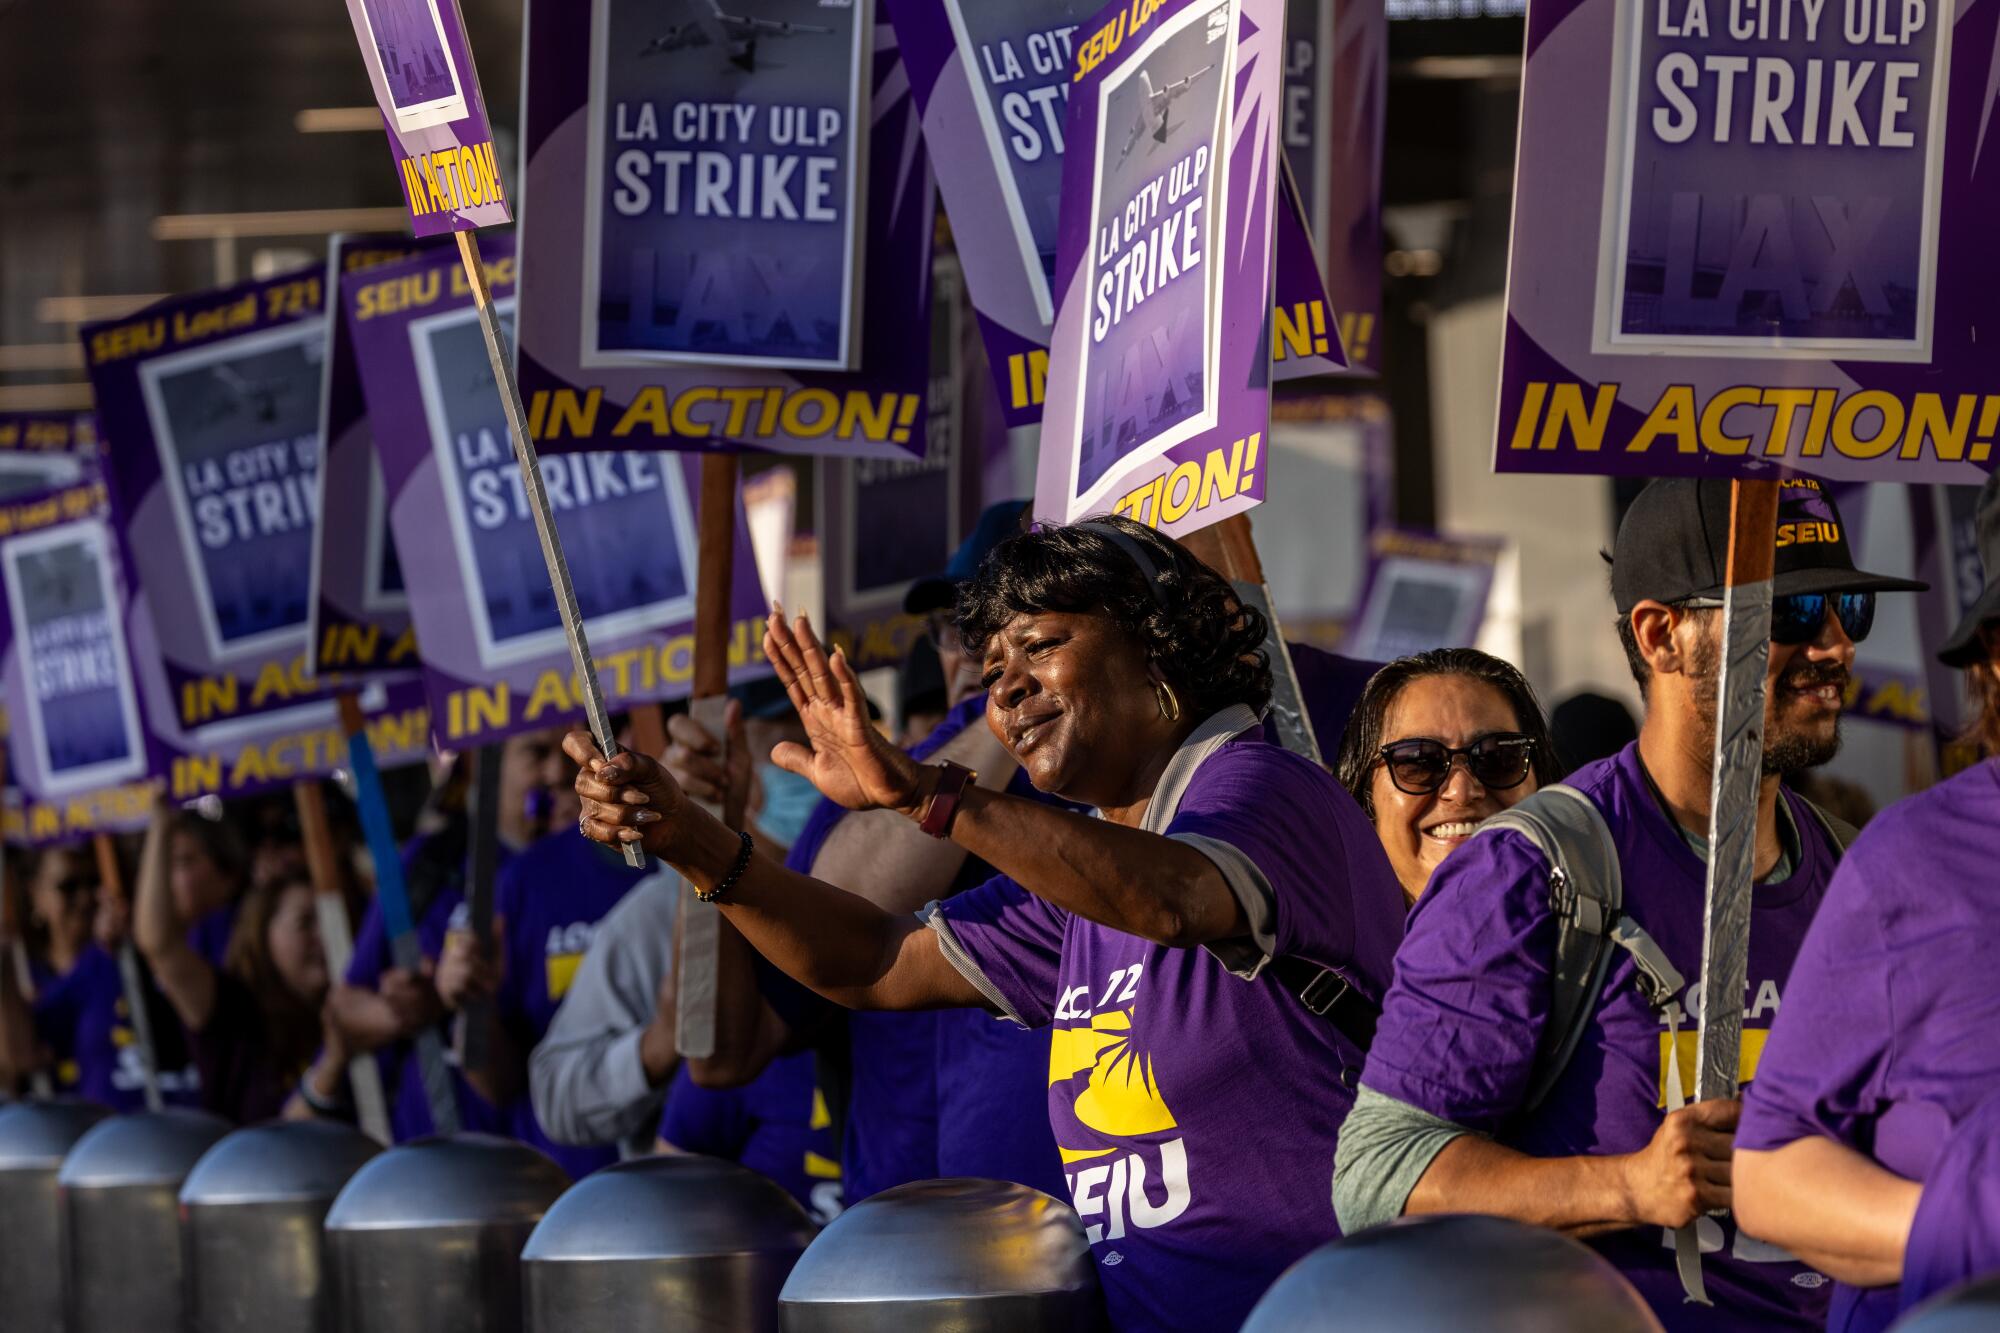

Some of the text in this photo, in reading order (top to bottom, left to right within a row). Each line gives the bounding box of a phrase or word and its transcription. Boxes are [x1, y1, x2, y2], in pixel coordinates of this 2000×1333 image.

[1074, 8, 1127, 83] SEIU
[1658, 0, 1927, 45] LA CITY ULP
[982, 25, 1079, 84] LA CIT
[615, 102, 841, 148] LA CITY ULP
[1002, 83, 1069, 162] ST
[1652, 52, 1920, 147] STRIKE
[420, 141, 503, 212] ACTION!
[613, 149, 838, 221] STRIKE
[1099, 145, 1208, 266] LA CITY ULP
[355, 268, 442, 321] SEIU
[1093, 196, 1203, 343] STRIKE
[530, 389, 602, 442] IN
[611, 386, 921, 444] ACTION!
[1510, 382, 2000, 462] IN ACTION!
[458, 426, 498, 468] LA
[1776, 521, 1840, 548] SEIU
[320, 624, 379, 664] IN
[182, 672, 239, 723] IN
[447, 681, 511, 739] IN
[172, 756, 221, 799] IN
